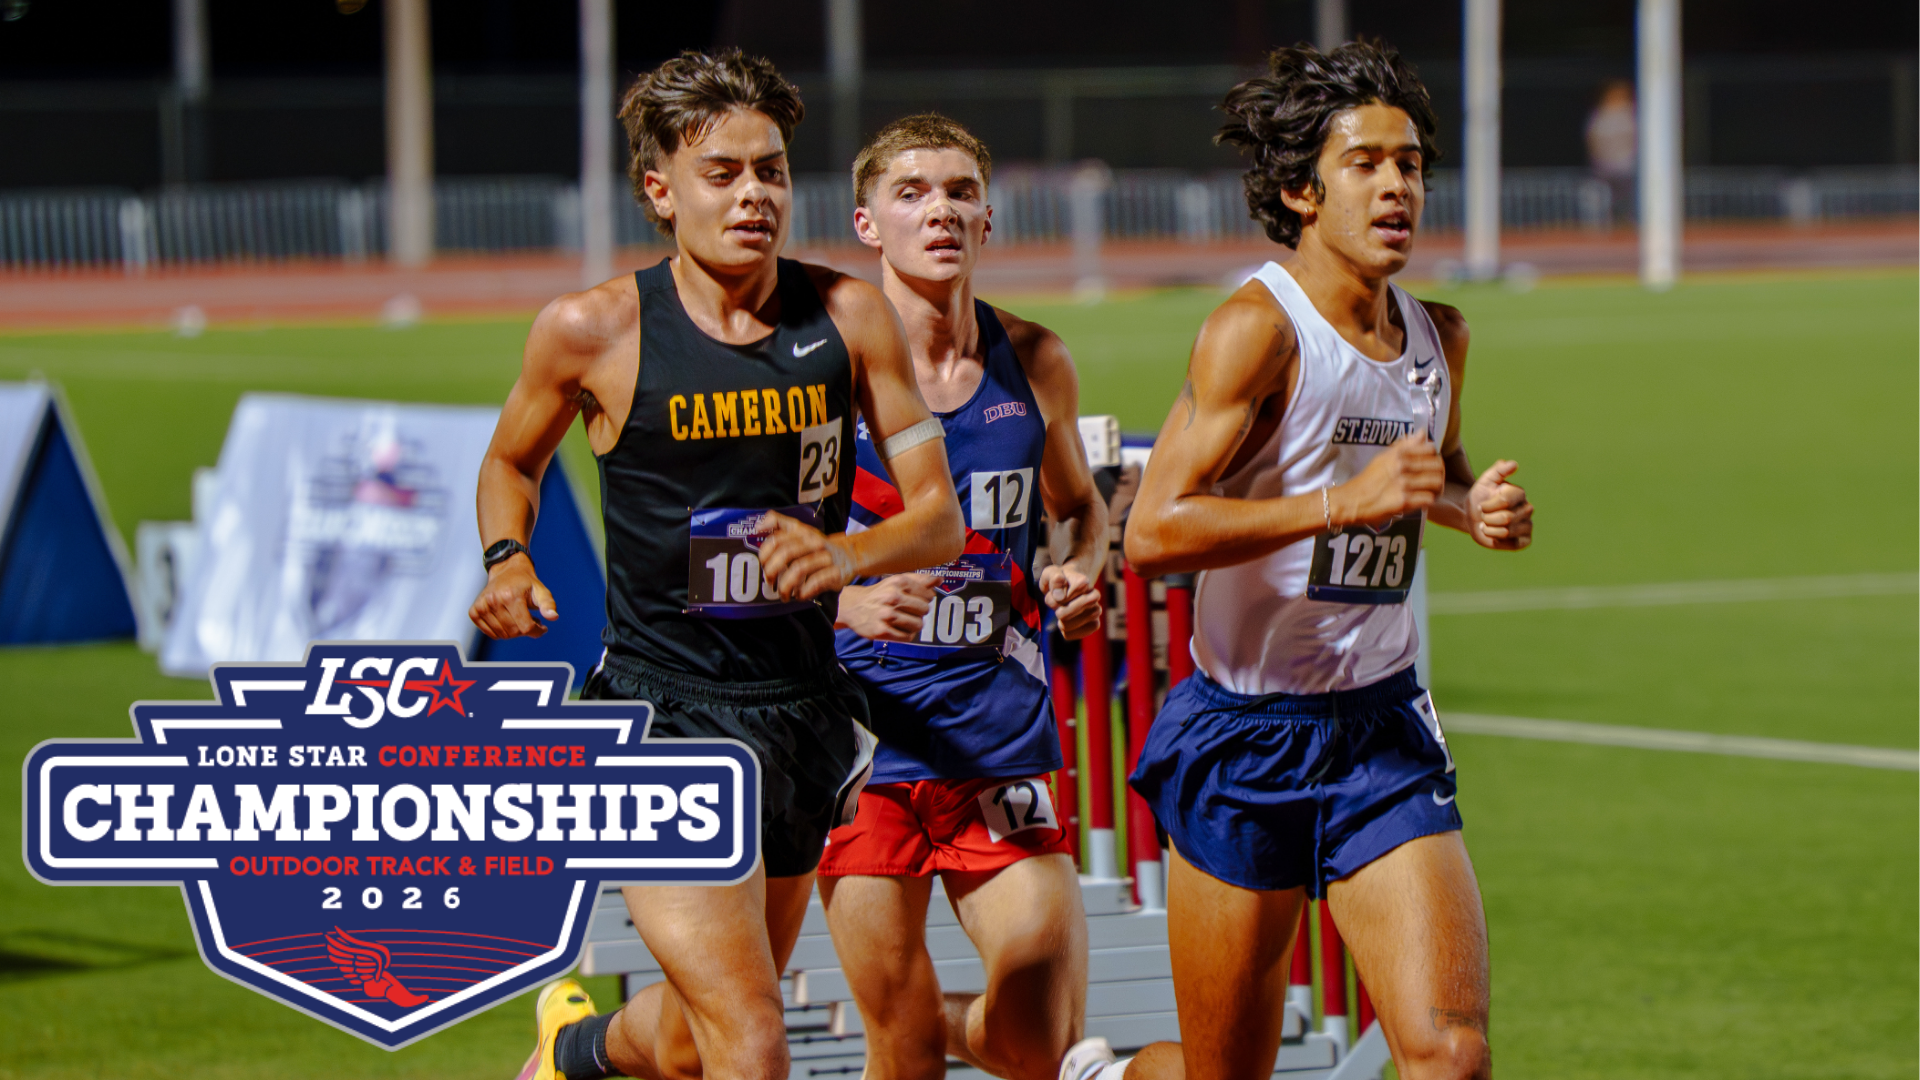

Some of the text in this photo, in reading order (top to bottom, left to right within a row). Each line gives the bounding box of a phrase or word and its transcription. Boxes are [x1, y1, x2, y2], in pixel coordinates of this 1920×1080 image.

[669, 384, 828, 441] CAMERON
[984, 401, 1027, 424] DBU
[800, 435, 838, 493] 23
[984, 472, 1024, 525] 12
[1327, 532, 1407, 588] 1273
[992, 781, 1048, 831] 12
